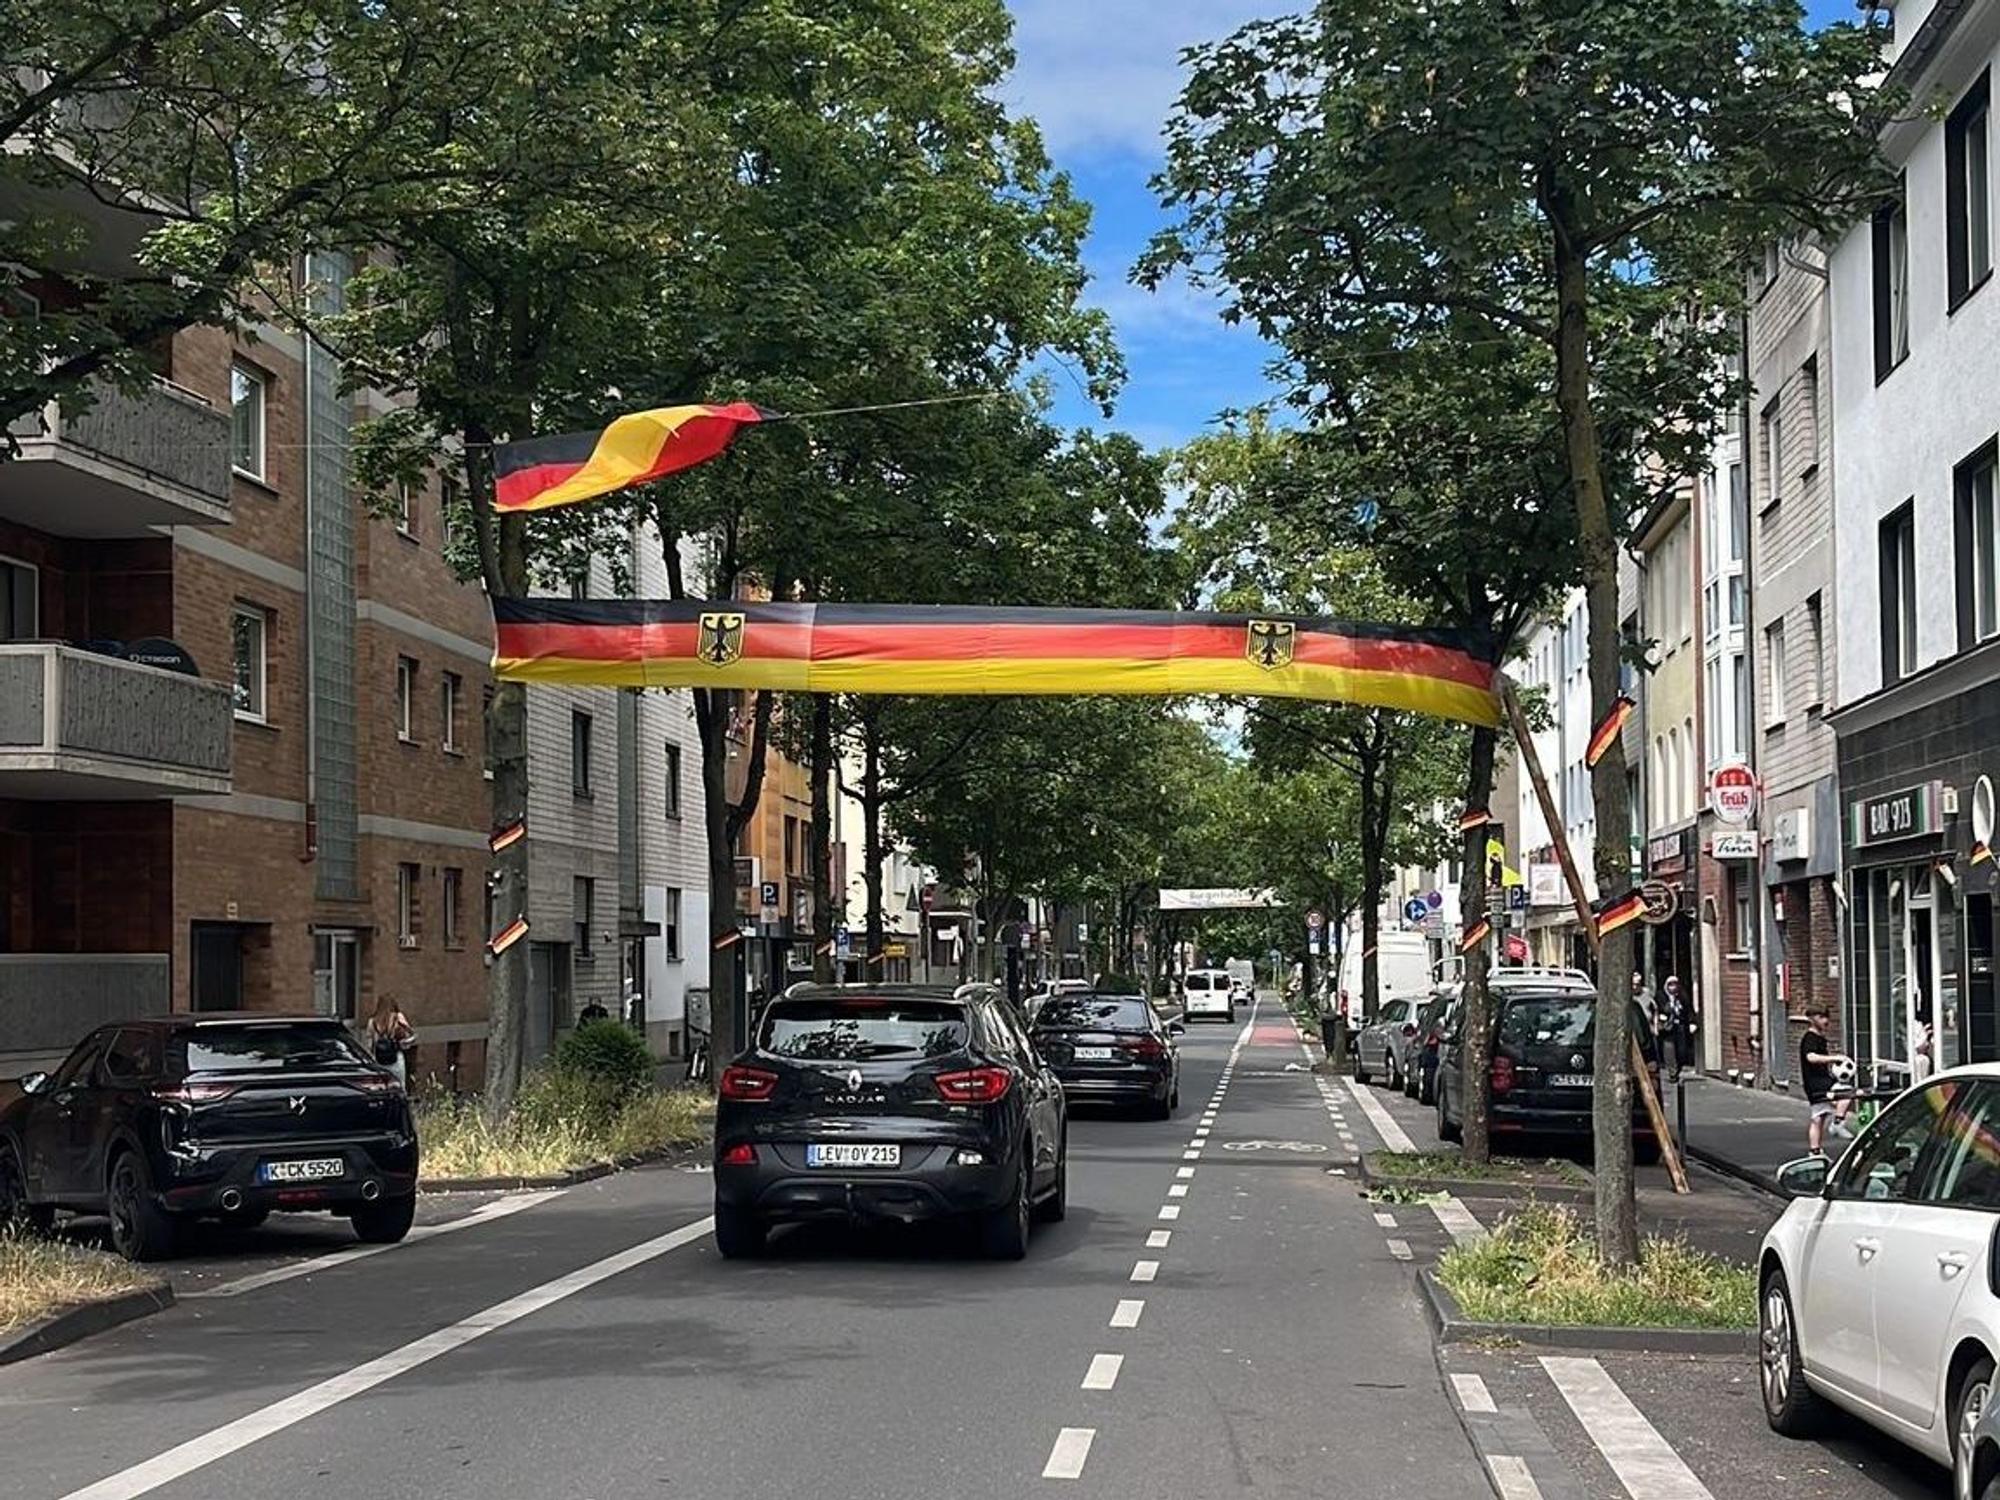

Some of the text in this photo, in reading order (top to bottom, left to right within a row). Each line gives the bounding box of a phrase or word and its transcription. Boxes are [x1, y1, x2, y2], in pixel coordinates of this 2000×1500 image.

[763, 885, 775, 903] P
[824, 1095, 885, 1103] KADJAR
[817, 1146, 897, 1161] LEV OY 215
[270, 1160, 342, 1178] K CK 5520
